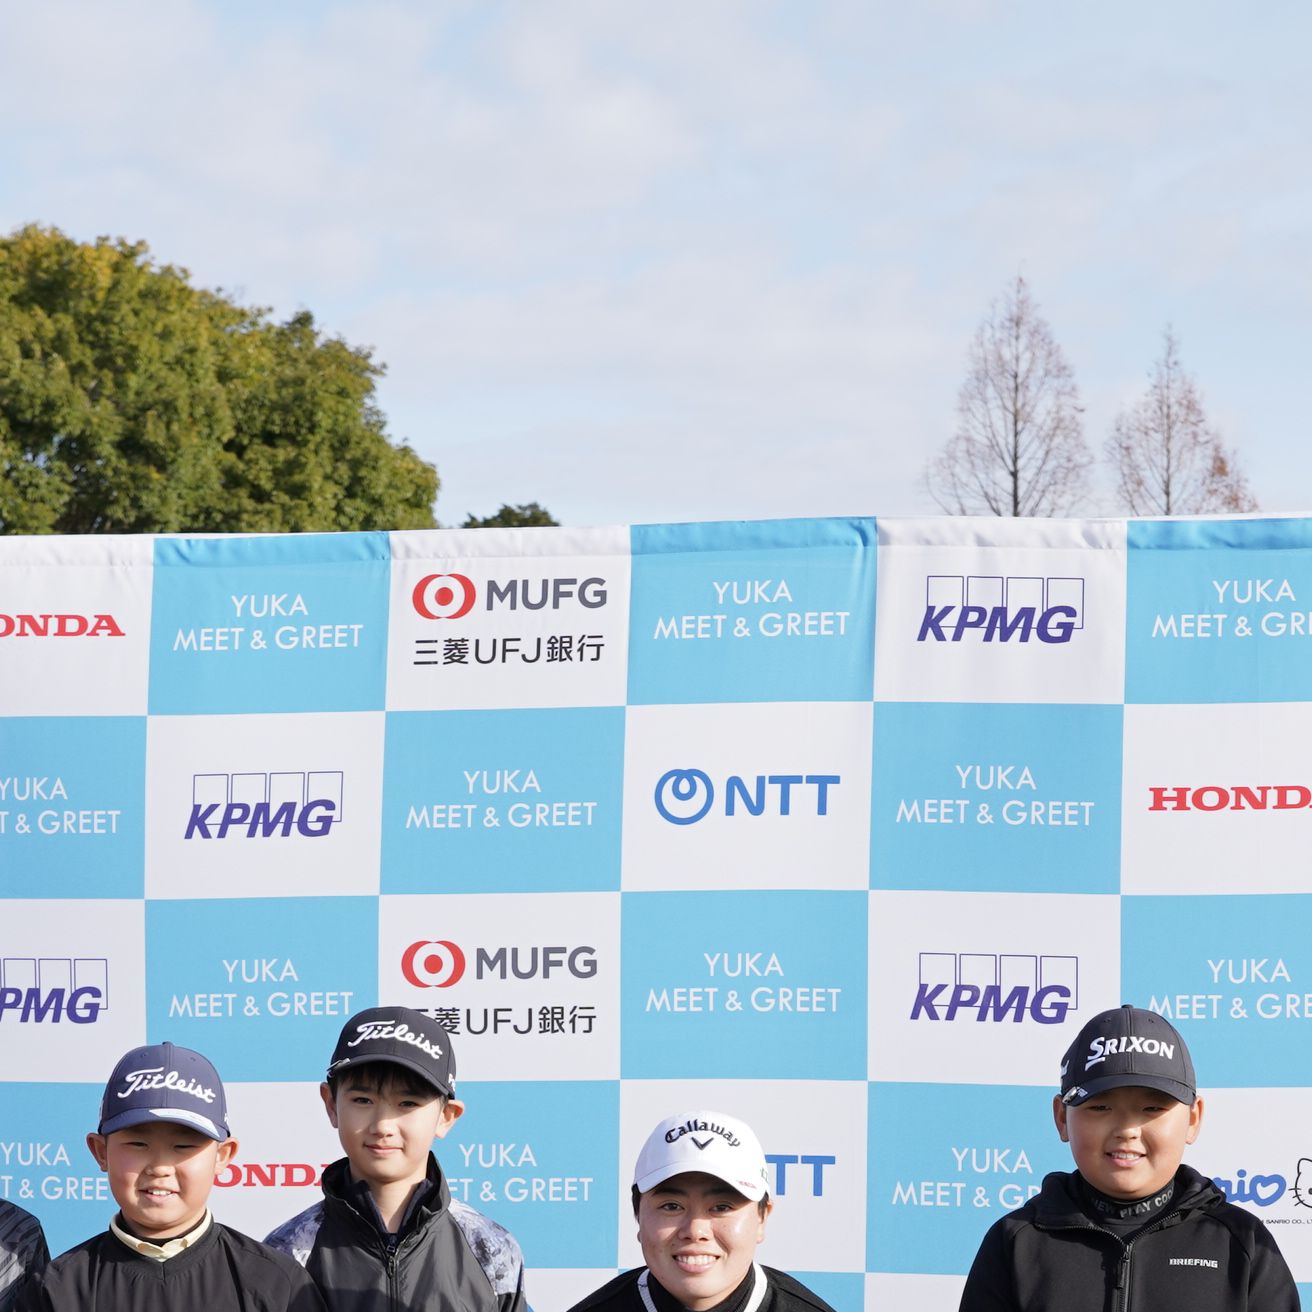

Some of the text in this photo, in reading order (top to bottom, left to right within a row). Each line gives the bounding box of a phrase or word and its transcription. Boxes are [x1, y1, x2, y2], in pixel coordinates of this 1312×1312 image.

[487, 578, 607, 611] MUFG
[713, 580, 792, 604] YUKA
[1213, 579, 1296, 603] YUKA
[232, 594, 308, 617] YUKA
[654, 612, 850, 639] MEET & GREET
[918, 605, 1077, 643] KPMG
[1152, 614, 1227, 637] MEET
[1235, 616, 1252, 636] &
[174, 624, 363, 650] MEET & GREET
[414, 635, 604, 665] 三菱UFJ銀行
[464, 770, 541, 793] YUKA
[956, 766, 1036, 790] YUKA
[725, 775, 840, 816] NTT
[15, 814, 31, 833] &
[38, 810, 120, 834] GREET
[184, 800, 336, 840] KPMG
[406, 802, 597, 828] MEET & GREET
[896, 800, 1094, 825] MEET & GREET
[223, 959, 298, 982] YUKA
[477, 946, 597, 979] MUFG
[704, 953, 784, 977] YUKA
[1208, 959, 1290, 983] YUKA
[170, 992, 356, 1019] MEET & GREET
[646, 987, 841, 1011] MEET & GREET
[910, 984, 1072, 1024] KPMG
[1145, 995, 1221, 1022] MEET
[1230, 998, 1248, 1018] &
[348, 1020, 443, 1060] Titleist
[1085, 1035, 1175, 1069] SRIXON
[118, 1066, 216, 1104] Titleist
[665, 1119, 742, 1149] Callaway
[1, 1142, 70, 1166] YUKA
[459, 1144, 536, 1168] YUKA
[952, 1148, 1032, 1173] YUKA
[19, 1178, 34, 1199] &
[41, 1176, 109, 1200] GREE
[764, 1155, 835, 1196] TT
[480, 1181, 496, 1201] &
[505, 1178, 593, 1202] GREET
[892, 1182, 966, 1206] MEET
[973, 1187, 990, 1207] &
[1170, 1258, 1218, 1268] BRIEFING
